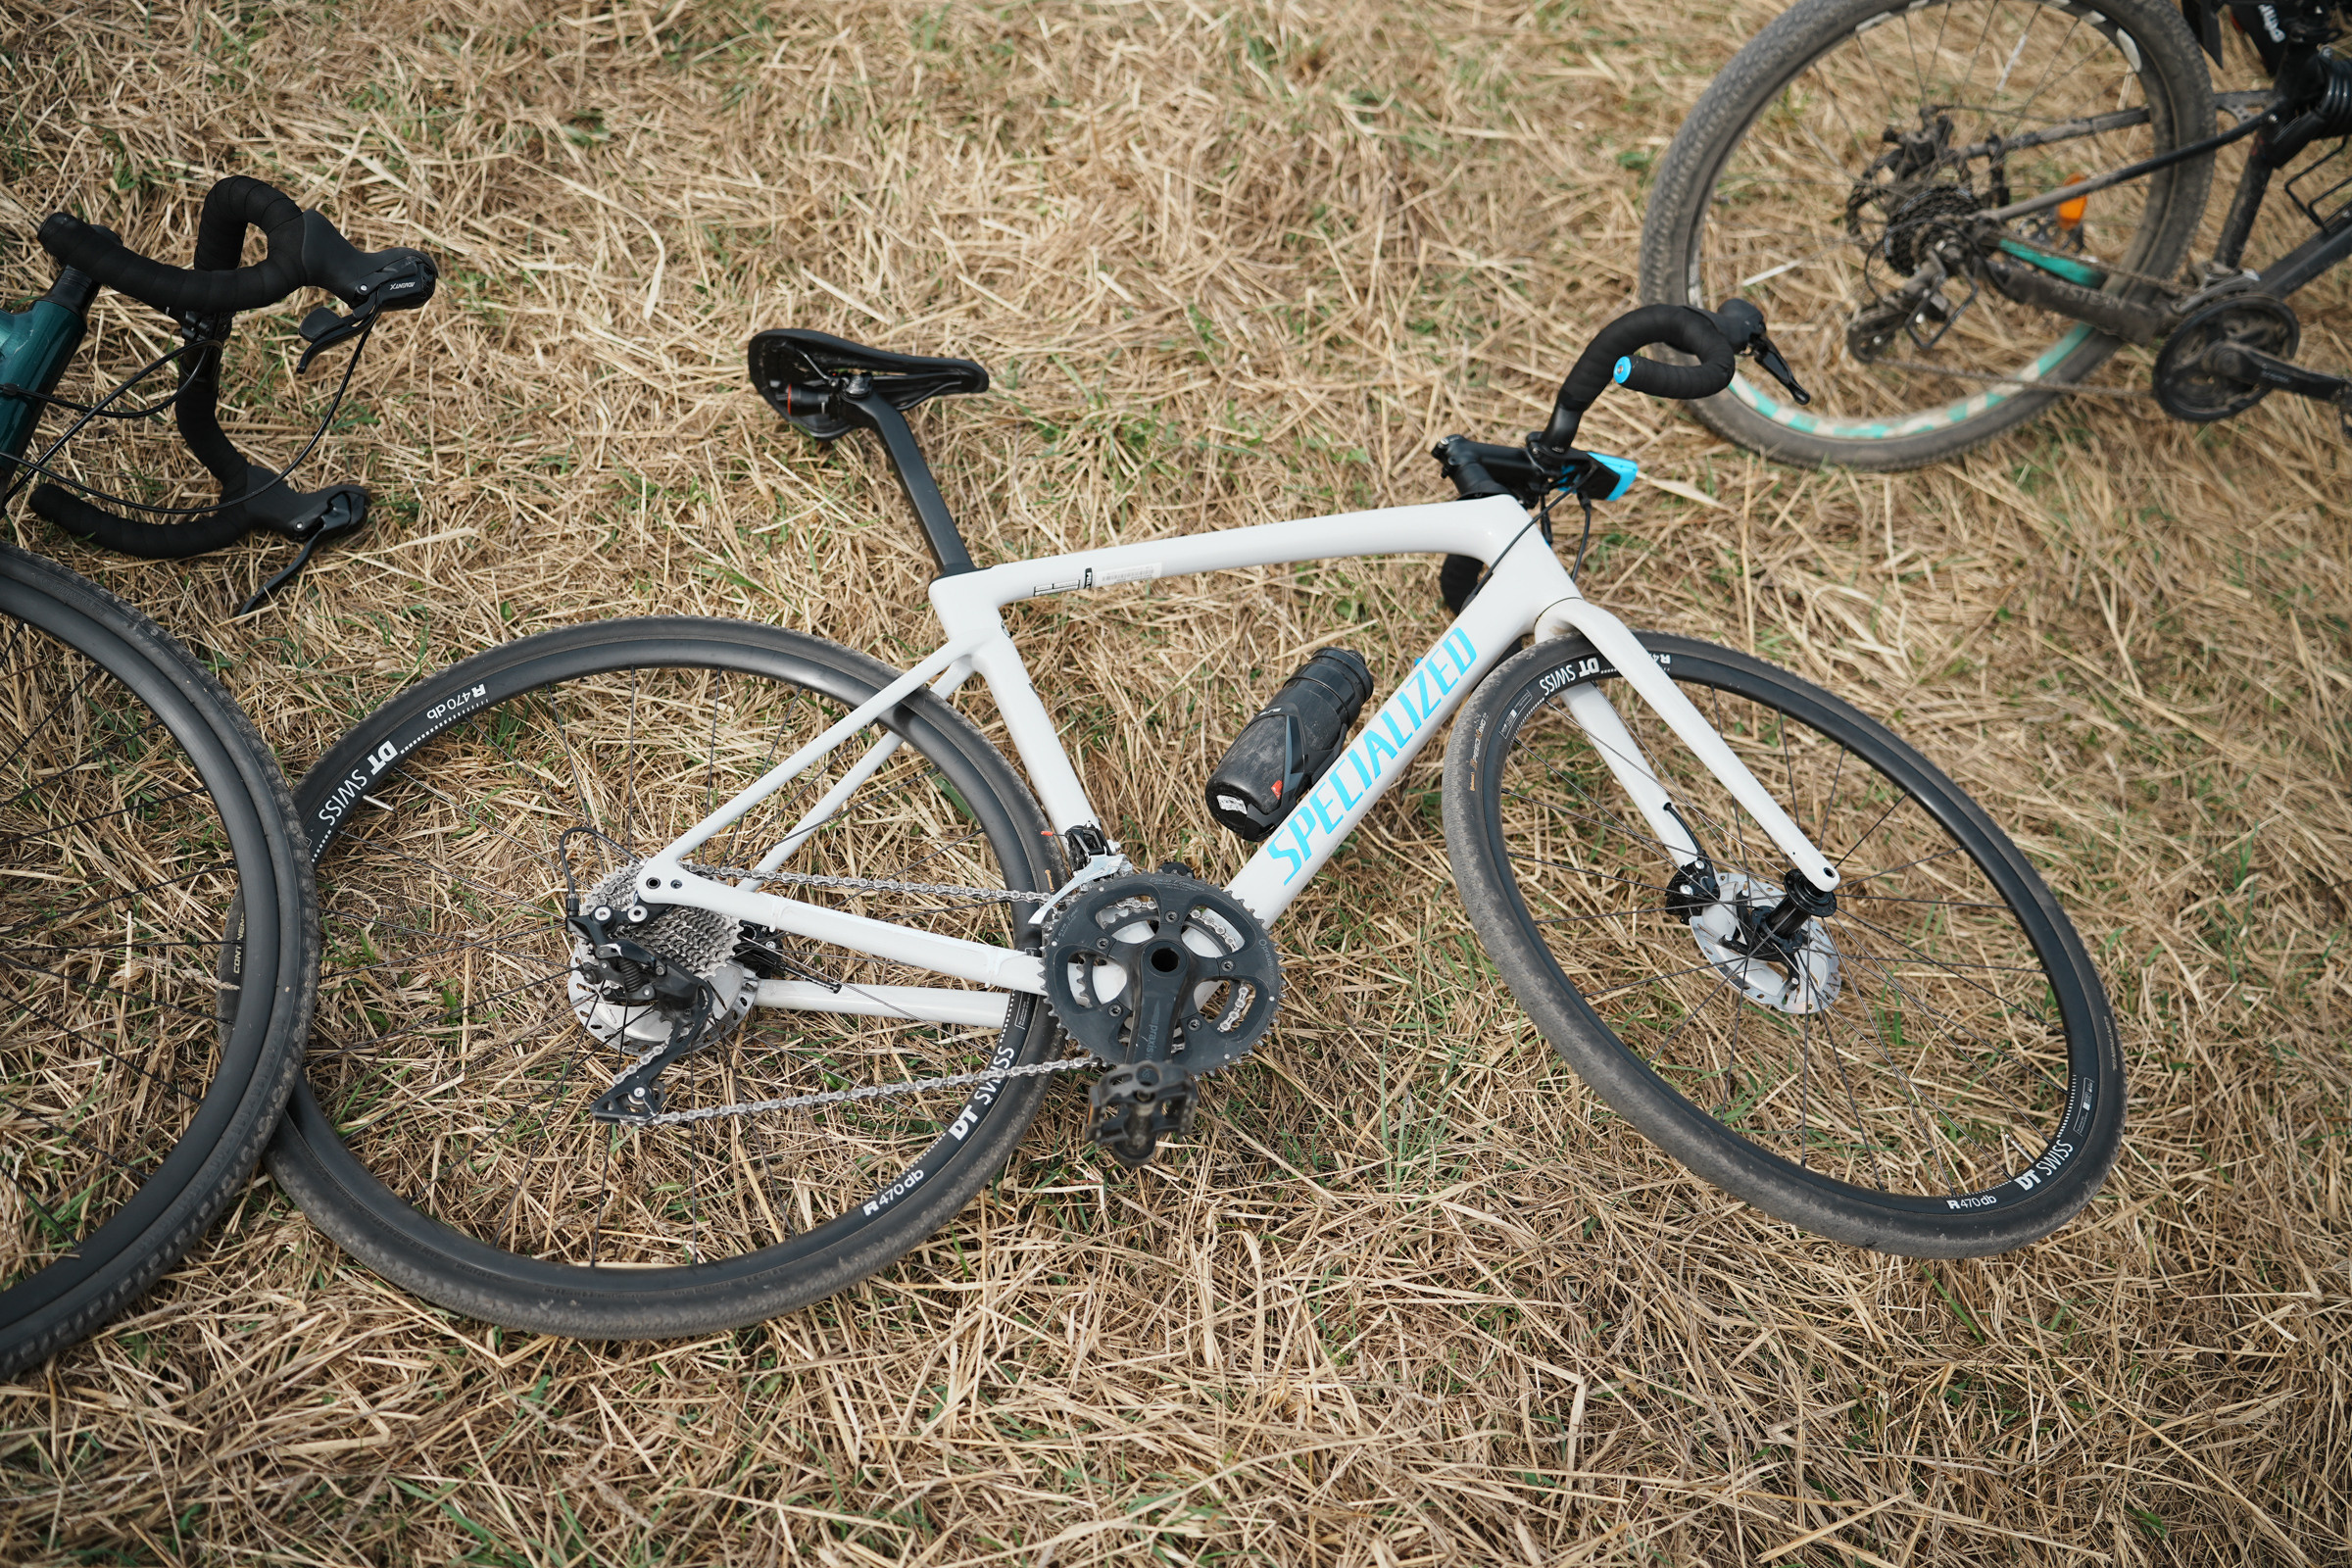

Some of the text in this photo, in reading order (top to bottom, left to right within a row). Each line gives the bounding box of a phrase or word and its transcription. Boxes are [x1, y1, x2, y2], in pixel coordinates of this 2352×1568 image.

[1539, 657, 1599, 696] DT SWISS
[1266, 626, 1478, 886] SPECIALIZED
[318, 740, 399, 827] DT SWISS
[948, 1104, 978, 1141] DT
[2014, 1140, 2074, 1191] DT SWISS
